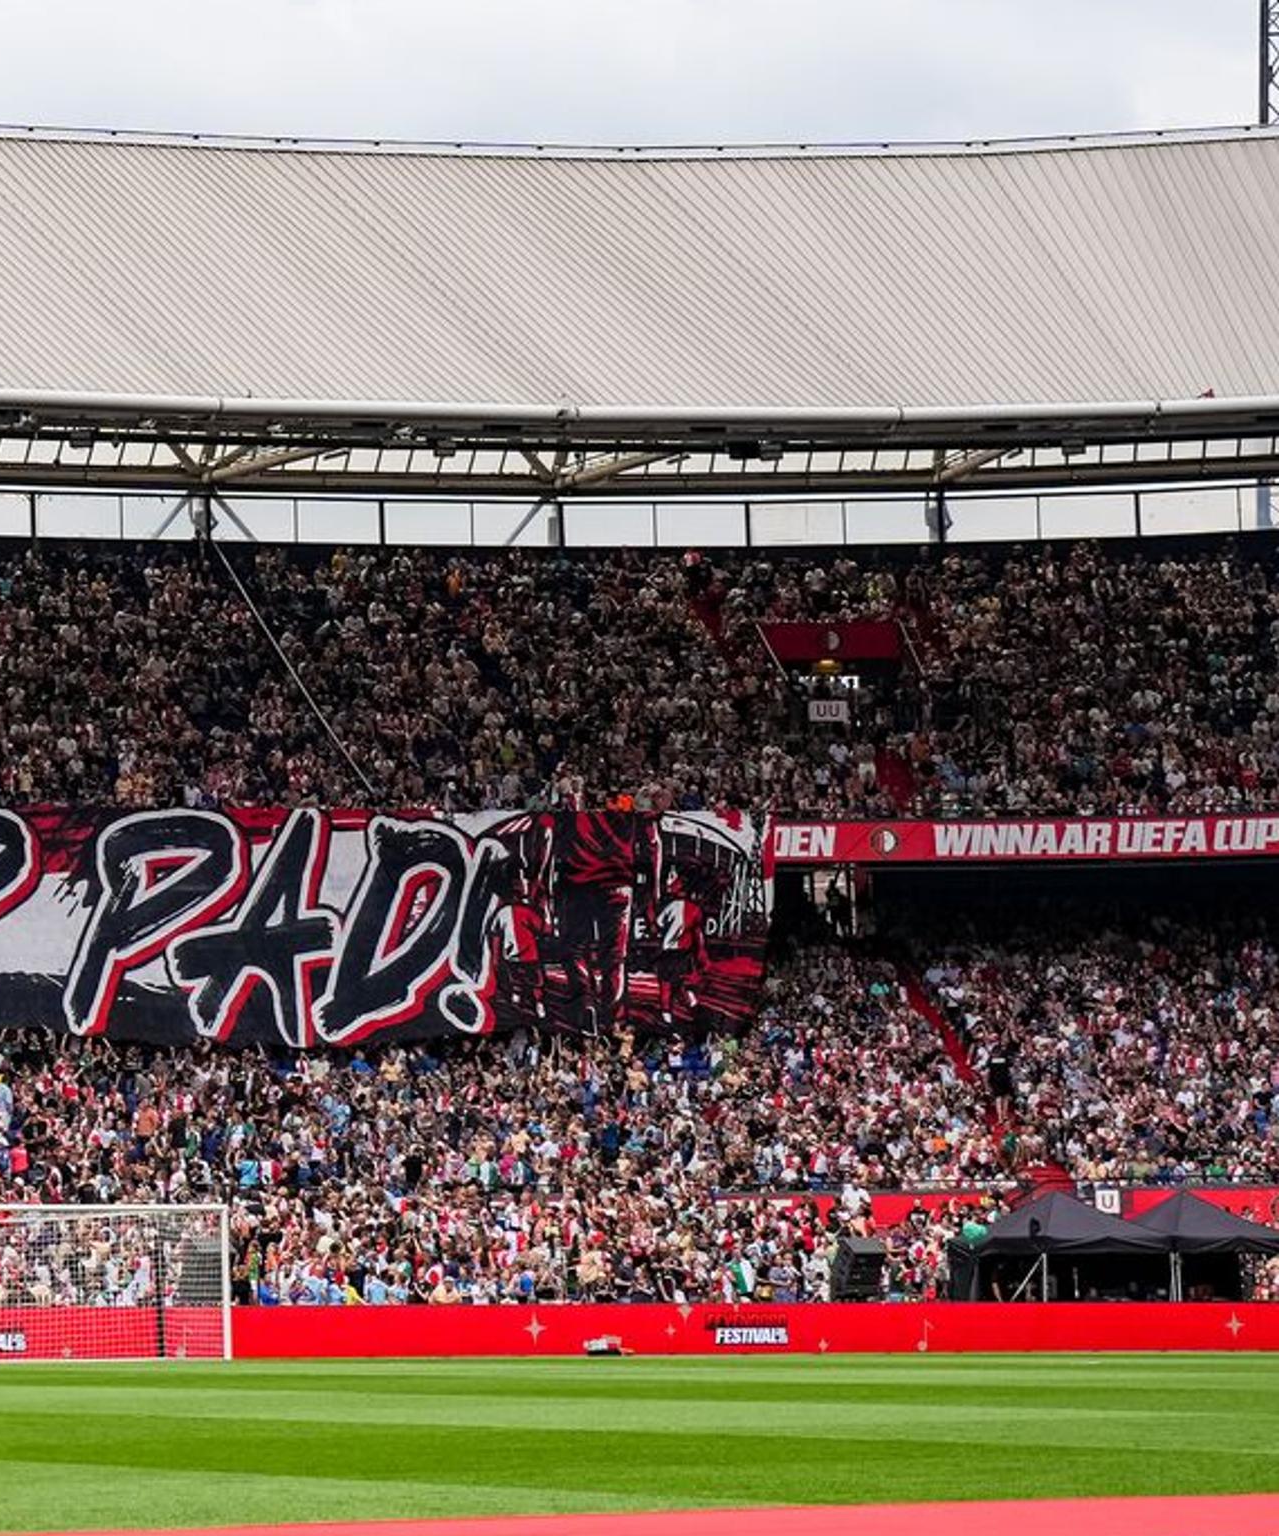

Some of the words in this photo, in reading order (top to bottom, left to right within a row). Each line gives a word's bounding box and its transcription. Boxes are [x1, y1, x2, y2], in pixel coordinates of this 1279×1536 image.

[816, 703, 840, 718] UU
[933, 822, 1112, 856] WINNAAR
[1117, 819, 1208, 853] UEFA
[1213, 818, 1279, 851] CUP
[63, 807, 497, 1048] PAD!
[1101, 1195, 1114, 1209] U
